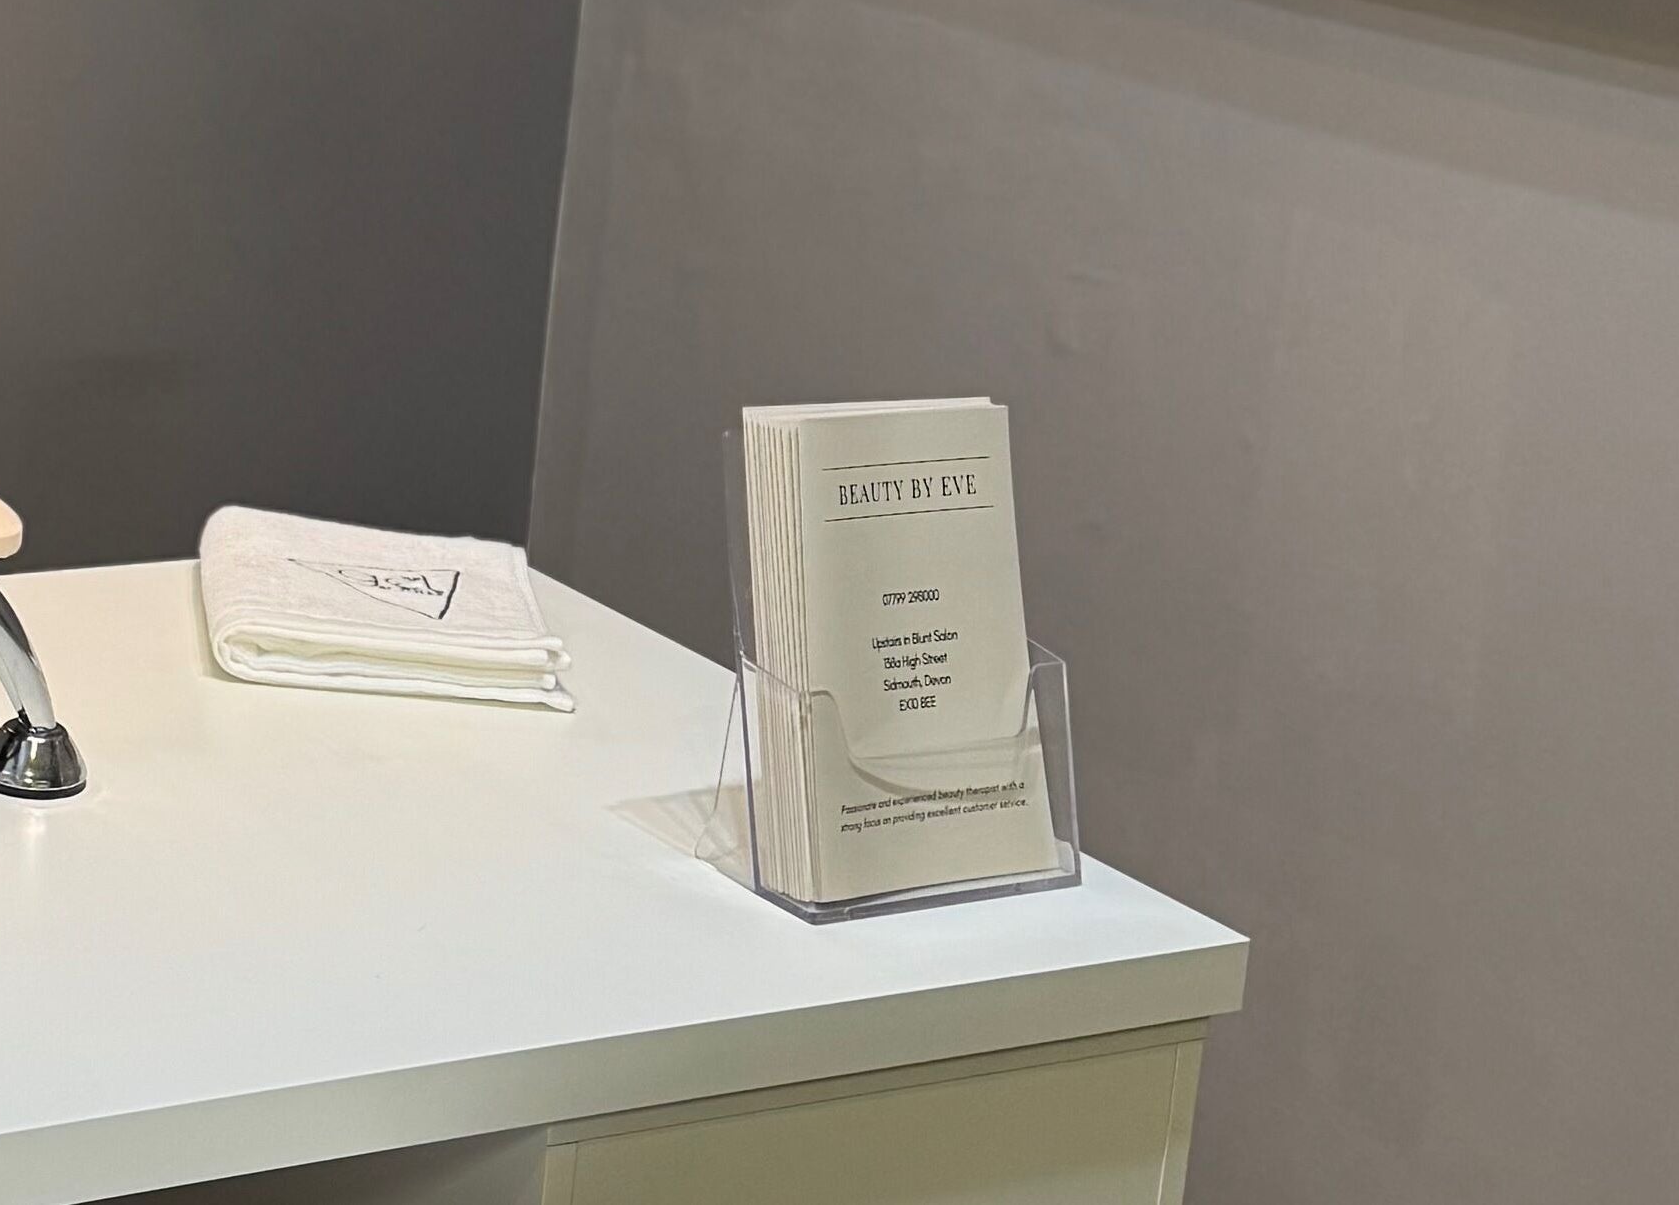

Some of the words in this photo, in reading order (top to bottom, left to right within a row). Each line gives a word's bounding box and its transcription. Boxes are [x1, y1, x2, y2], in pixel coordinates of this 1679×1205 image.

[838, 479, 904, 506] BEAUTY
[911, 476, 933, 499] BY
[941, 474, 977, 497] EVE
[872, 637, 902, 653] Upstairs
[903, 636, 911, 645] in
[912, 632, 933, 645] Blunt
[933, 628, 958, 642] Salon
[902, 652, 921, 670] High
[922, 652, 948, 665] Street
[924, 674, 952, 687] Devon
[878, 798, 892, 809] and
[892, 790, 937, 807] experienced
[938, 788, 965, 801] beauty
[966, 784, 1000, 797] therapist
[1001, 780, 1018, 792] with
[863, 817, 881, 829] focus
[882, 817, 892, 826] on
[892, 810, 926, 826] providing
[927, 805, 961, 819] excellent
[962, 802, 999, 815] customer
